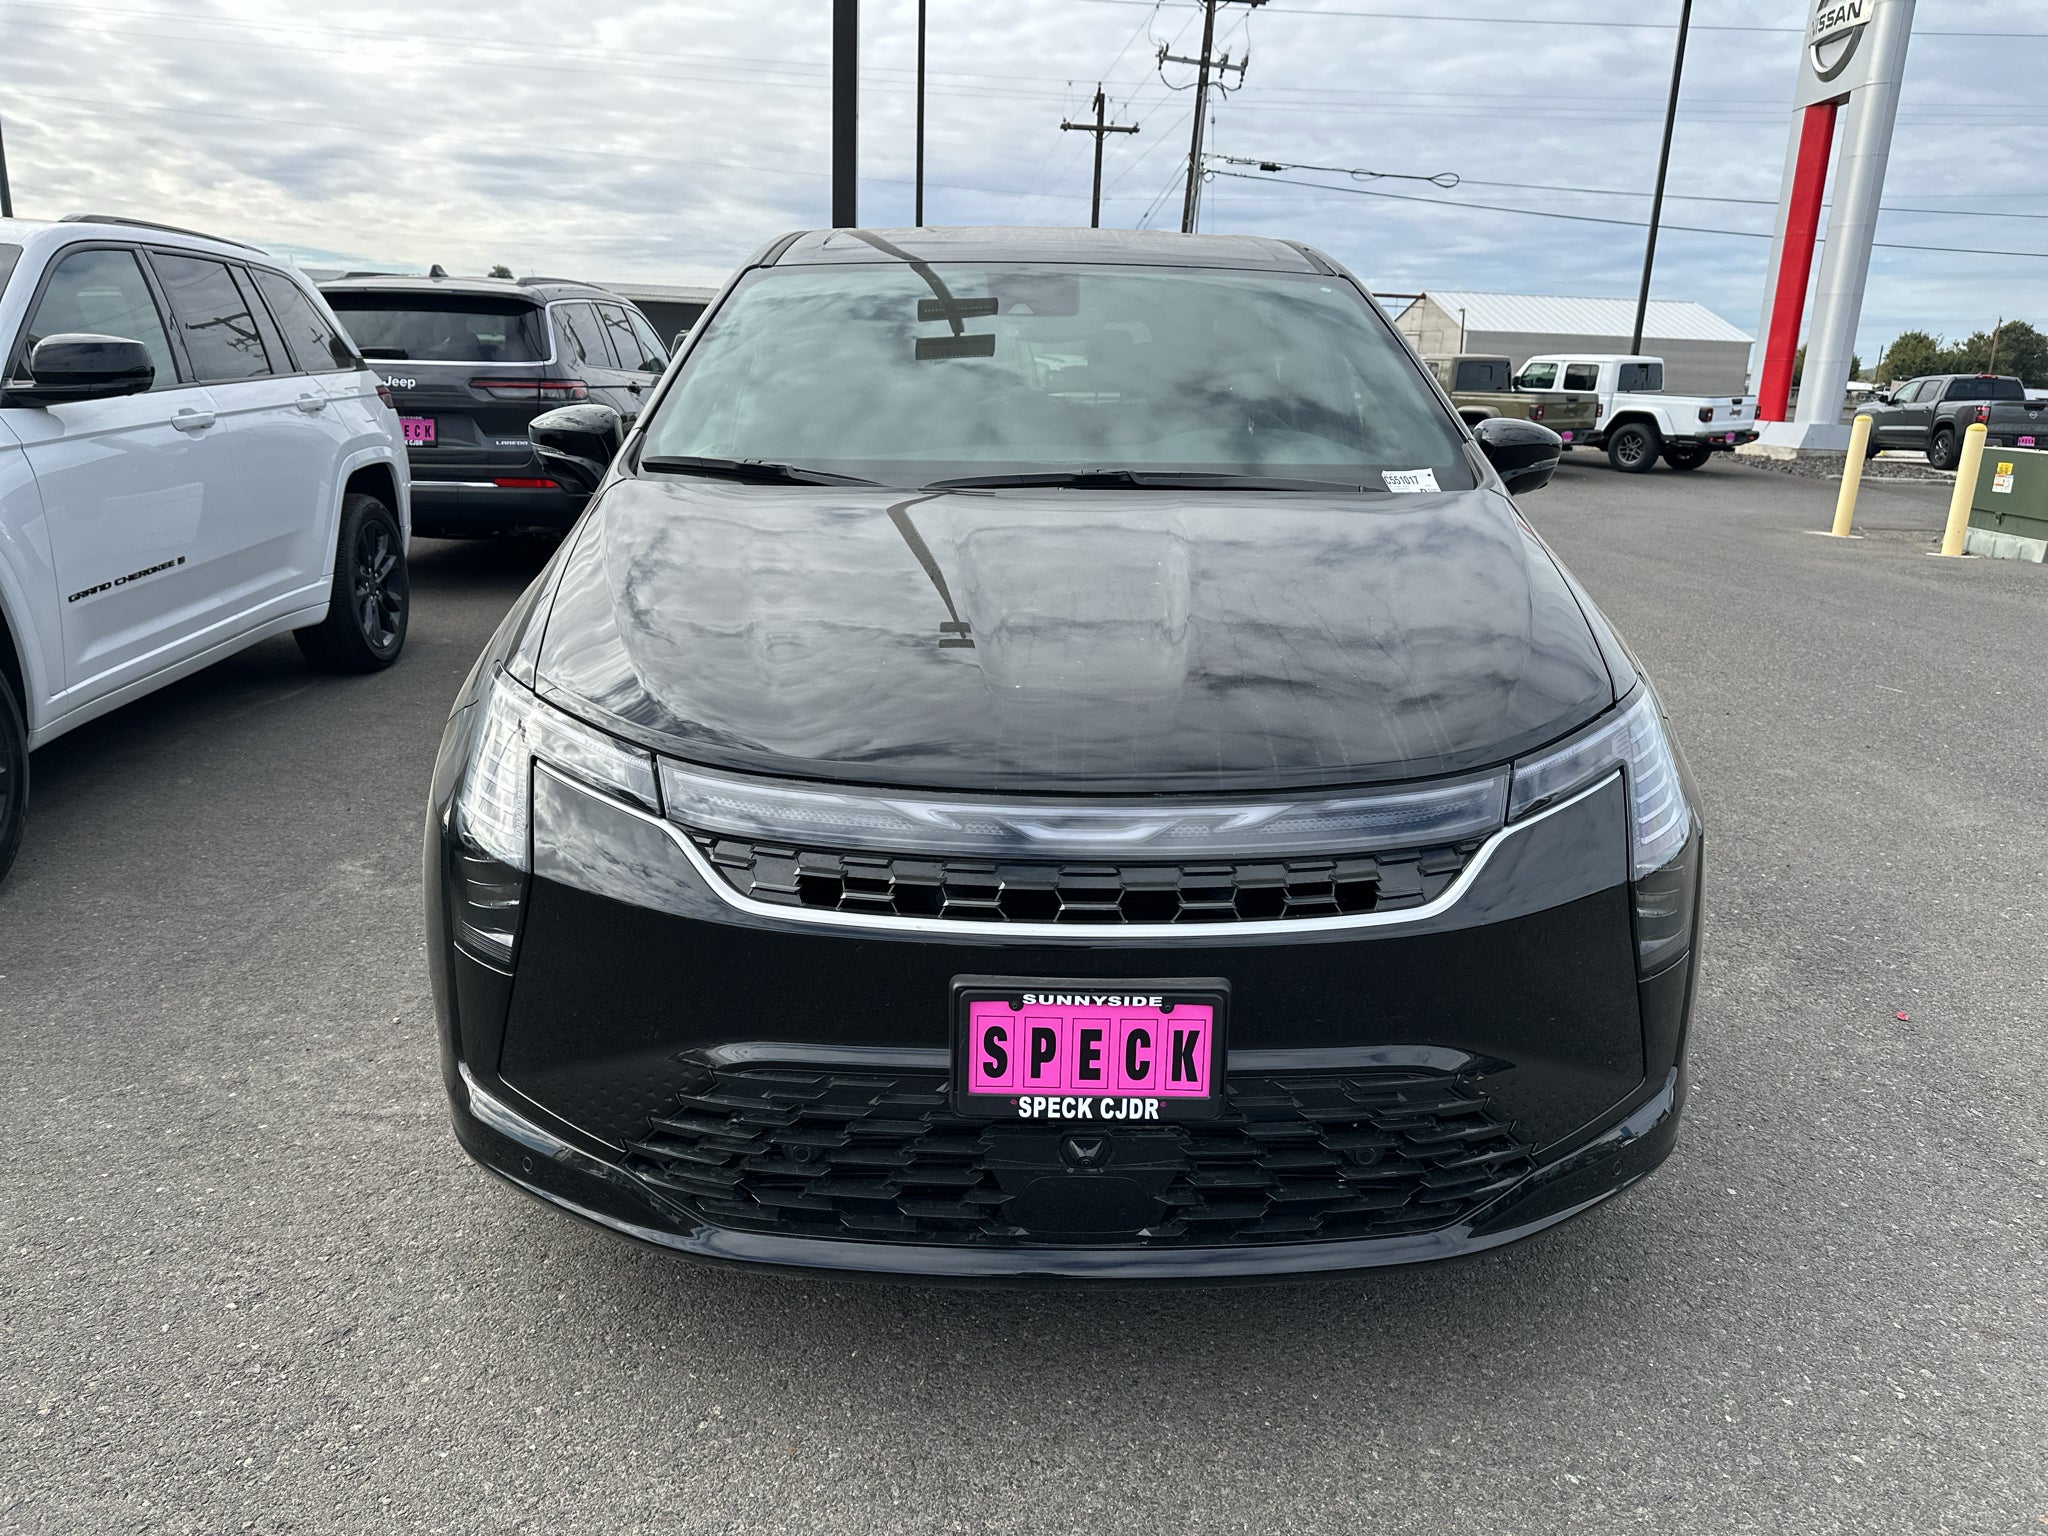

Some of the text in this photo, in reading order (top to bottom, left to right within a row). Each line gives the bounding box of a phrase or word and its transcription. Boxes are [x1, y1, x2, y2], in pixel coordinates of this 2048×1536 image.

[382, 375, 416, 390] Jeep
[404, 424, 432, 438] ECK
[68, 559, 176, 603] GRAND CHEROKEE
[1022, 994, 1163, 1007] SUNNYSIDE
[982, 1025, 1201, 1083] SPECK
[1018, 1096, 1160, 1120] SPECK CJDR
